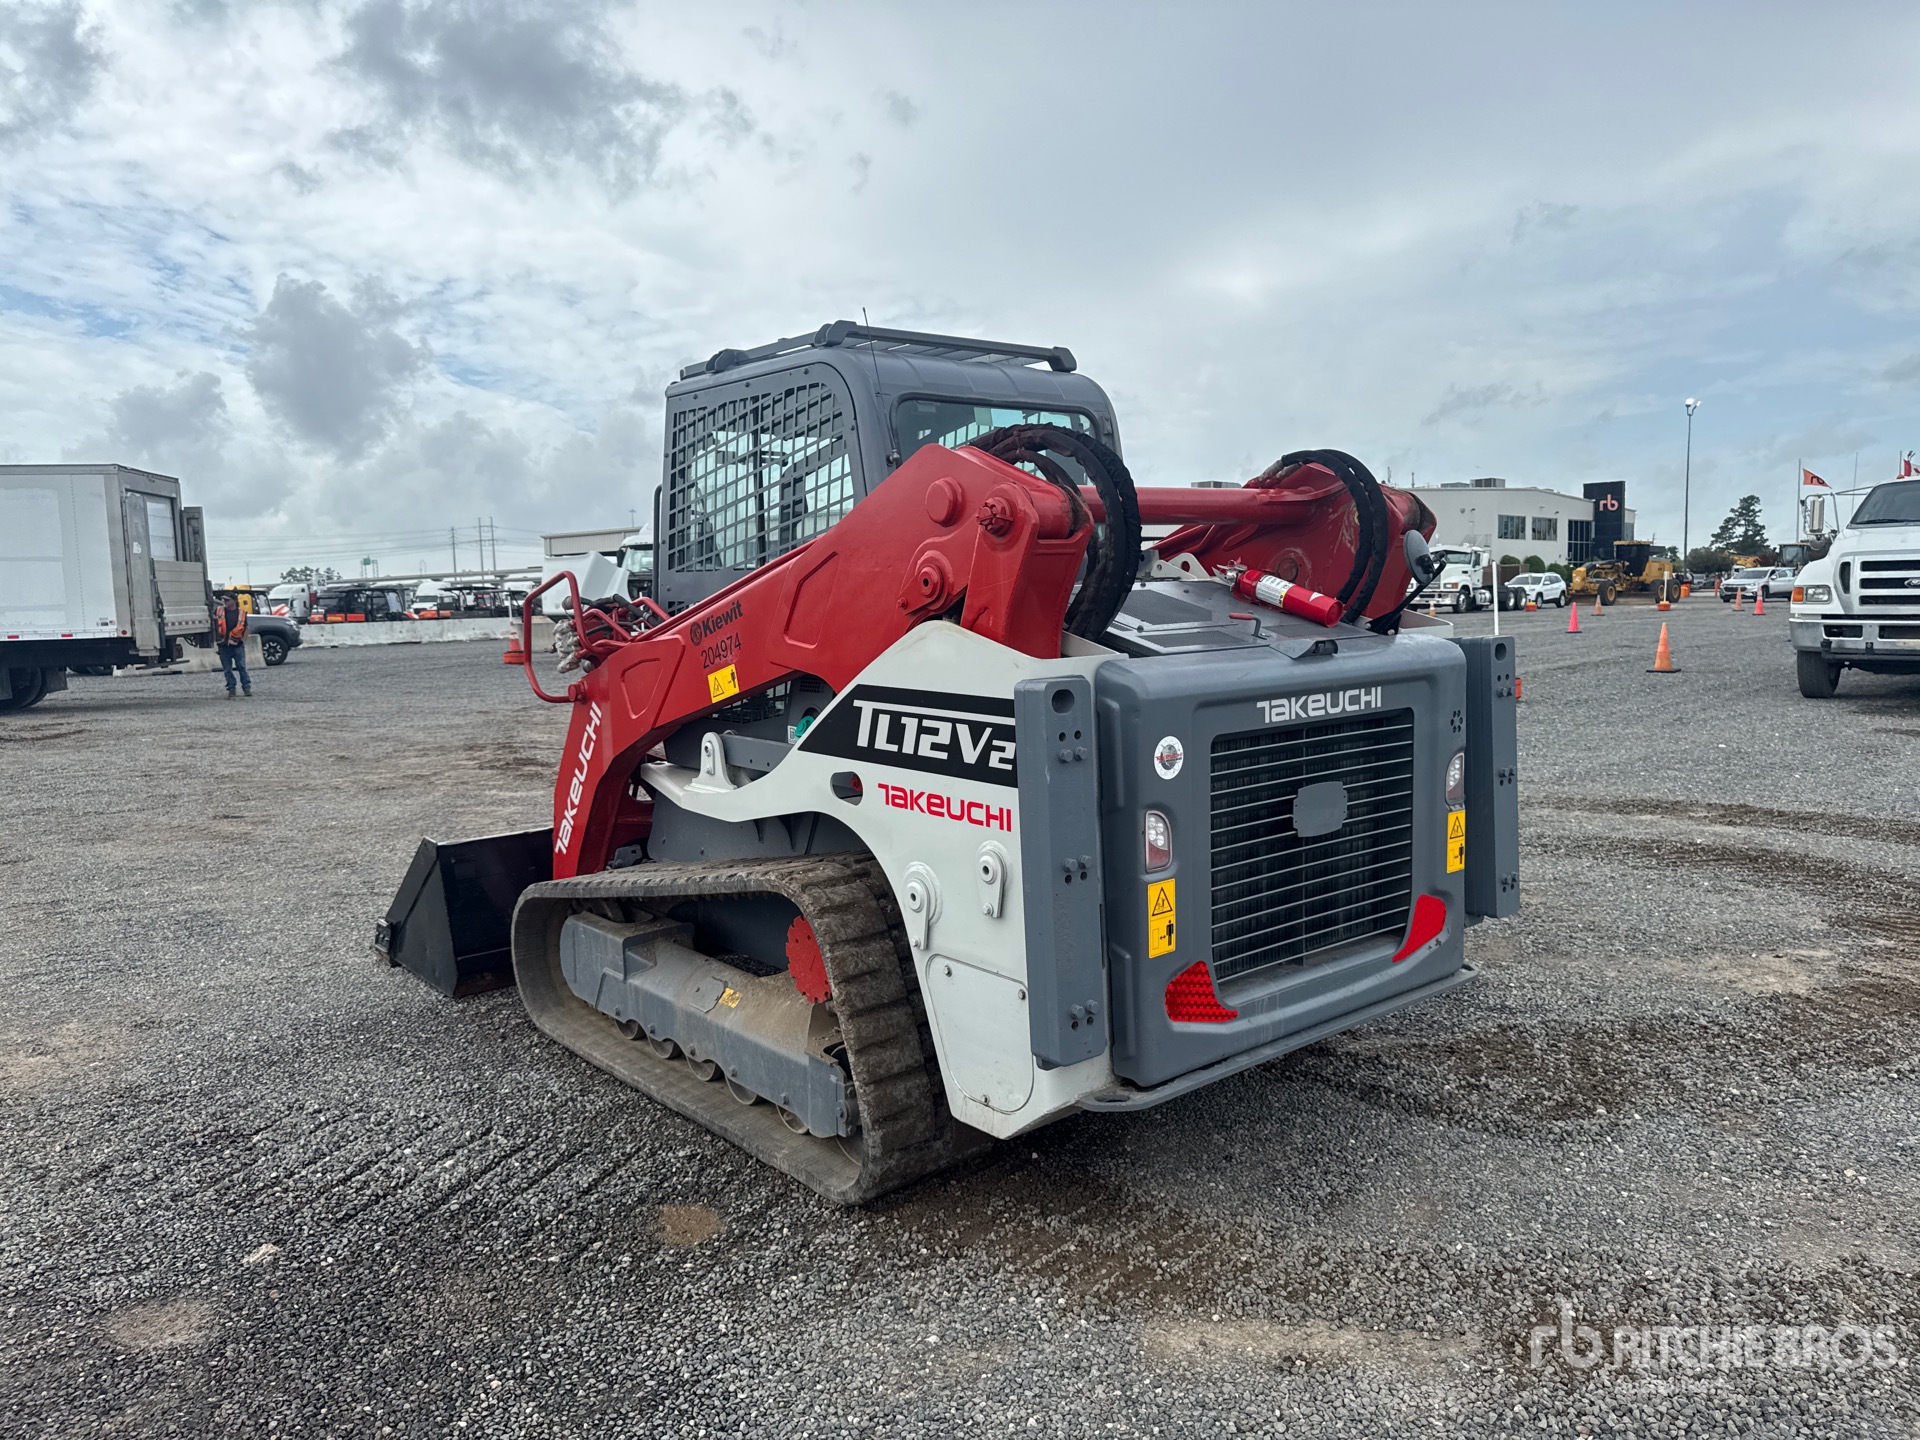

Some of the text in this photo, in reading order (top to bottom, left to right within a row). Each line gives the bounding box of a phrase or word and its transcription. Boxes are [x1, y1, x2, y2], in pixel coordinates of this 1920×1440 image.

[1599, 493, 1619, 512] rb
[702, 600, 744, 638] Kiewit
[701, 632, 742, 669] 204974
[1256, 686, 1382, 724] TAKEUCHI
[554, 701, 602, 856] TAKEUCHI
[877, 782, 1013, 832] TAKEUCHI
